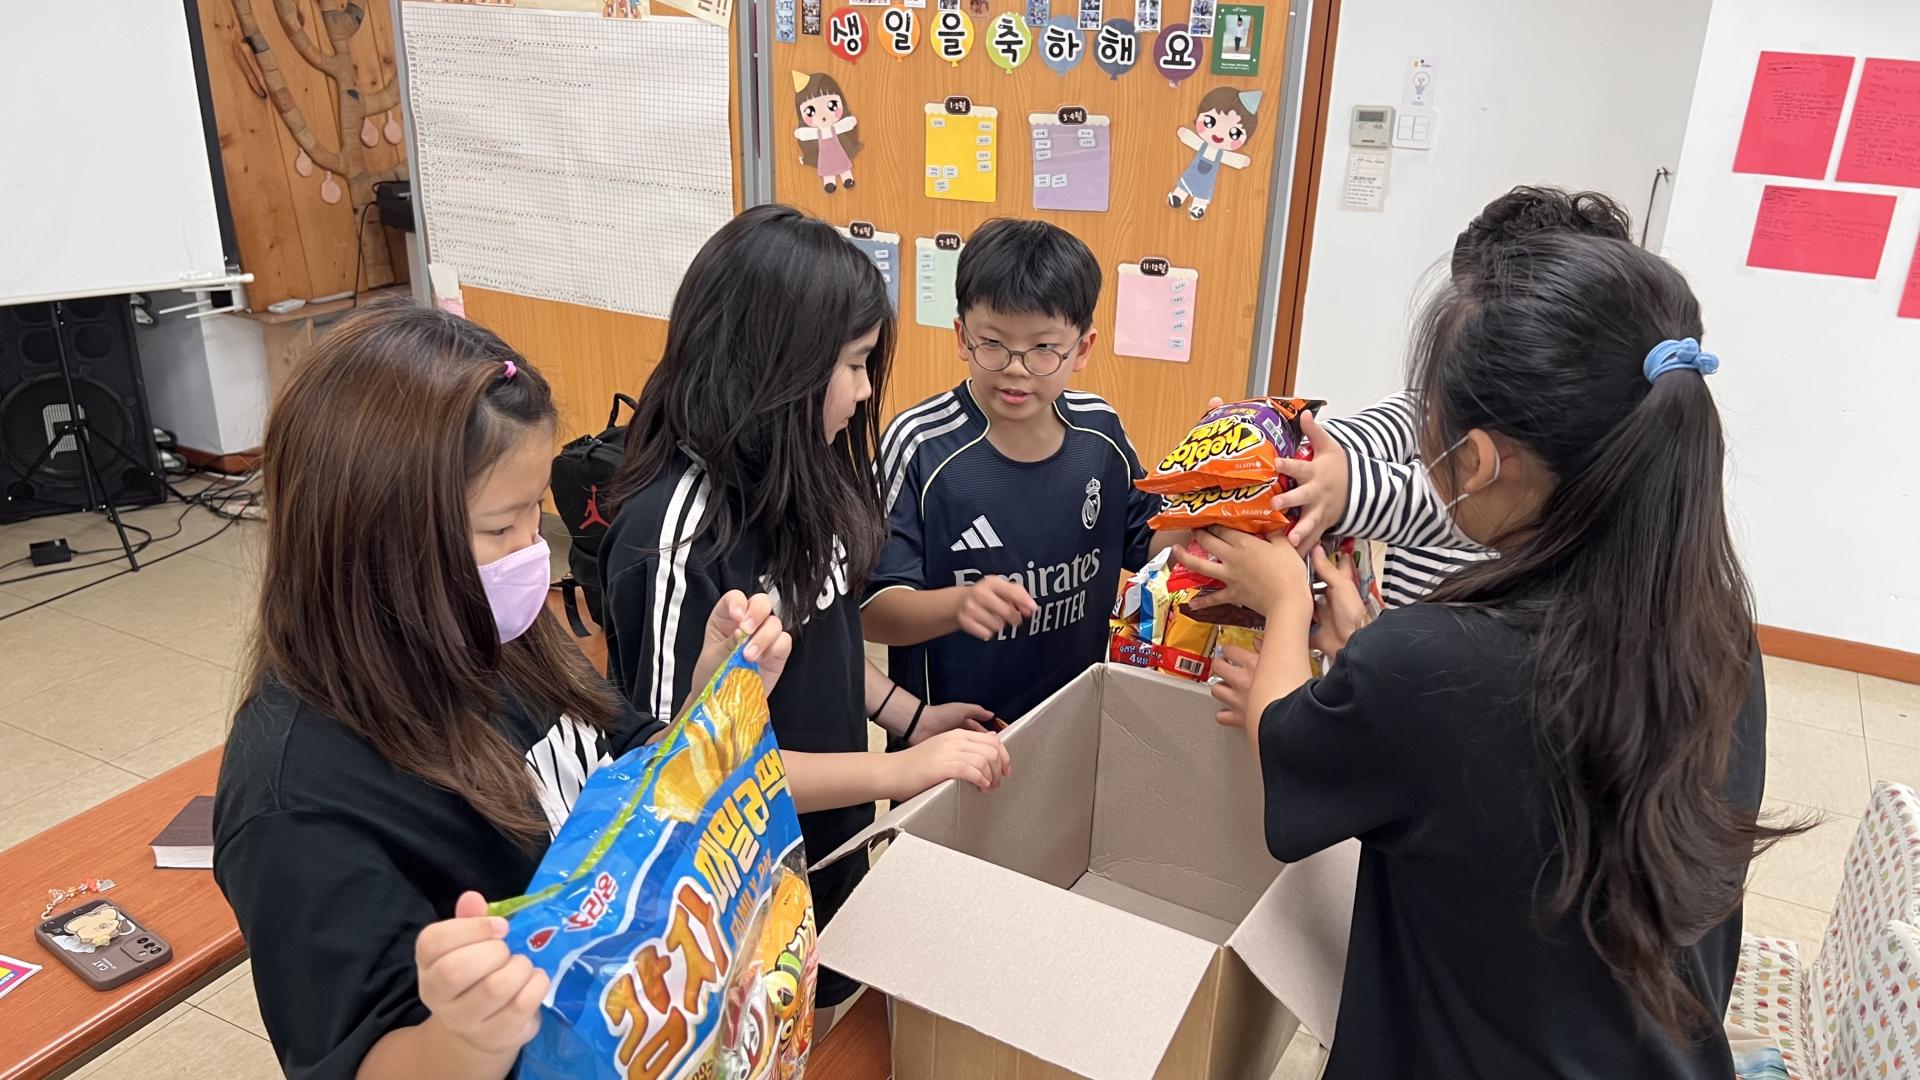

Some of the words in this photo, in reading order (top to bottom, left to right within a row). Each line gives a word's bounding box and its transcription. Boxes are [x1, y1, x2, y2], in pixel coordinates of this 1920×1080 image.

[832, 10, 965, 57] 생일을
[995, 19, 1193, 67] 축하해요
[1158, 421, 1265, 472] Cheetos
[953, 548, 1101, 600] Eirates
[1029, 589, 1086, 637] BETTER
[565, 872, 619, 931] 오리온
